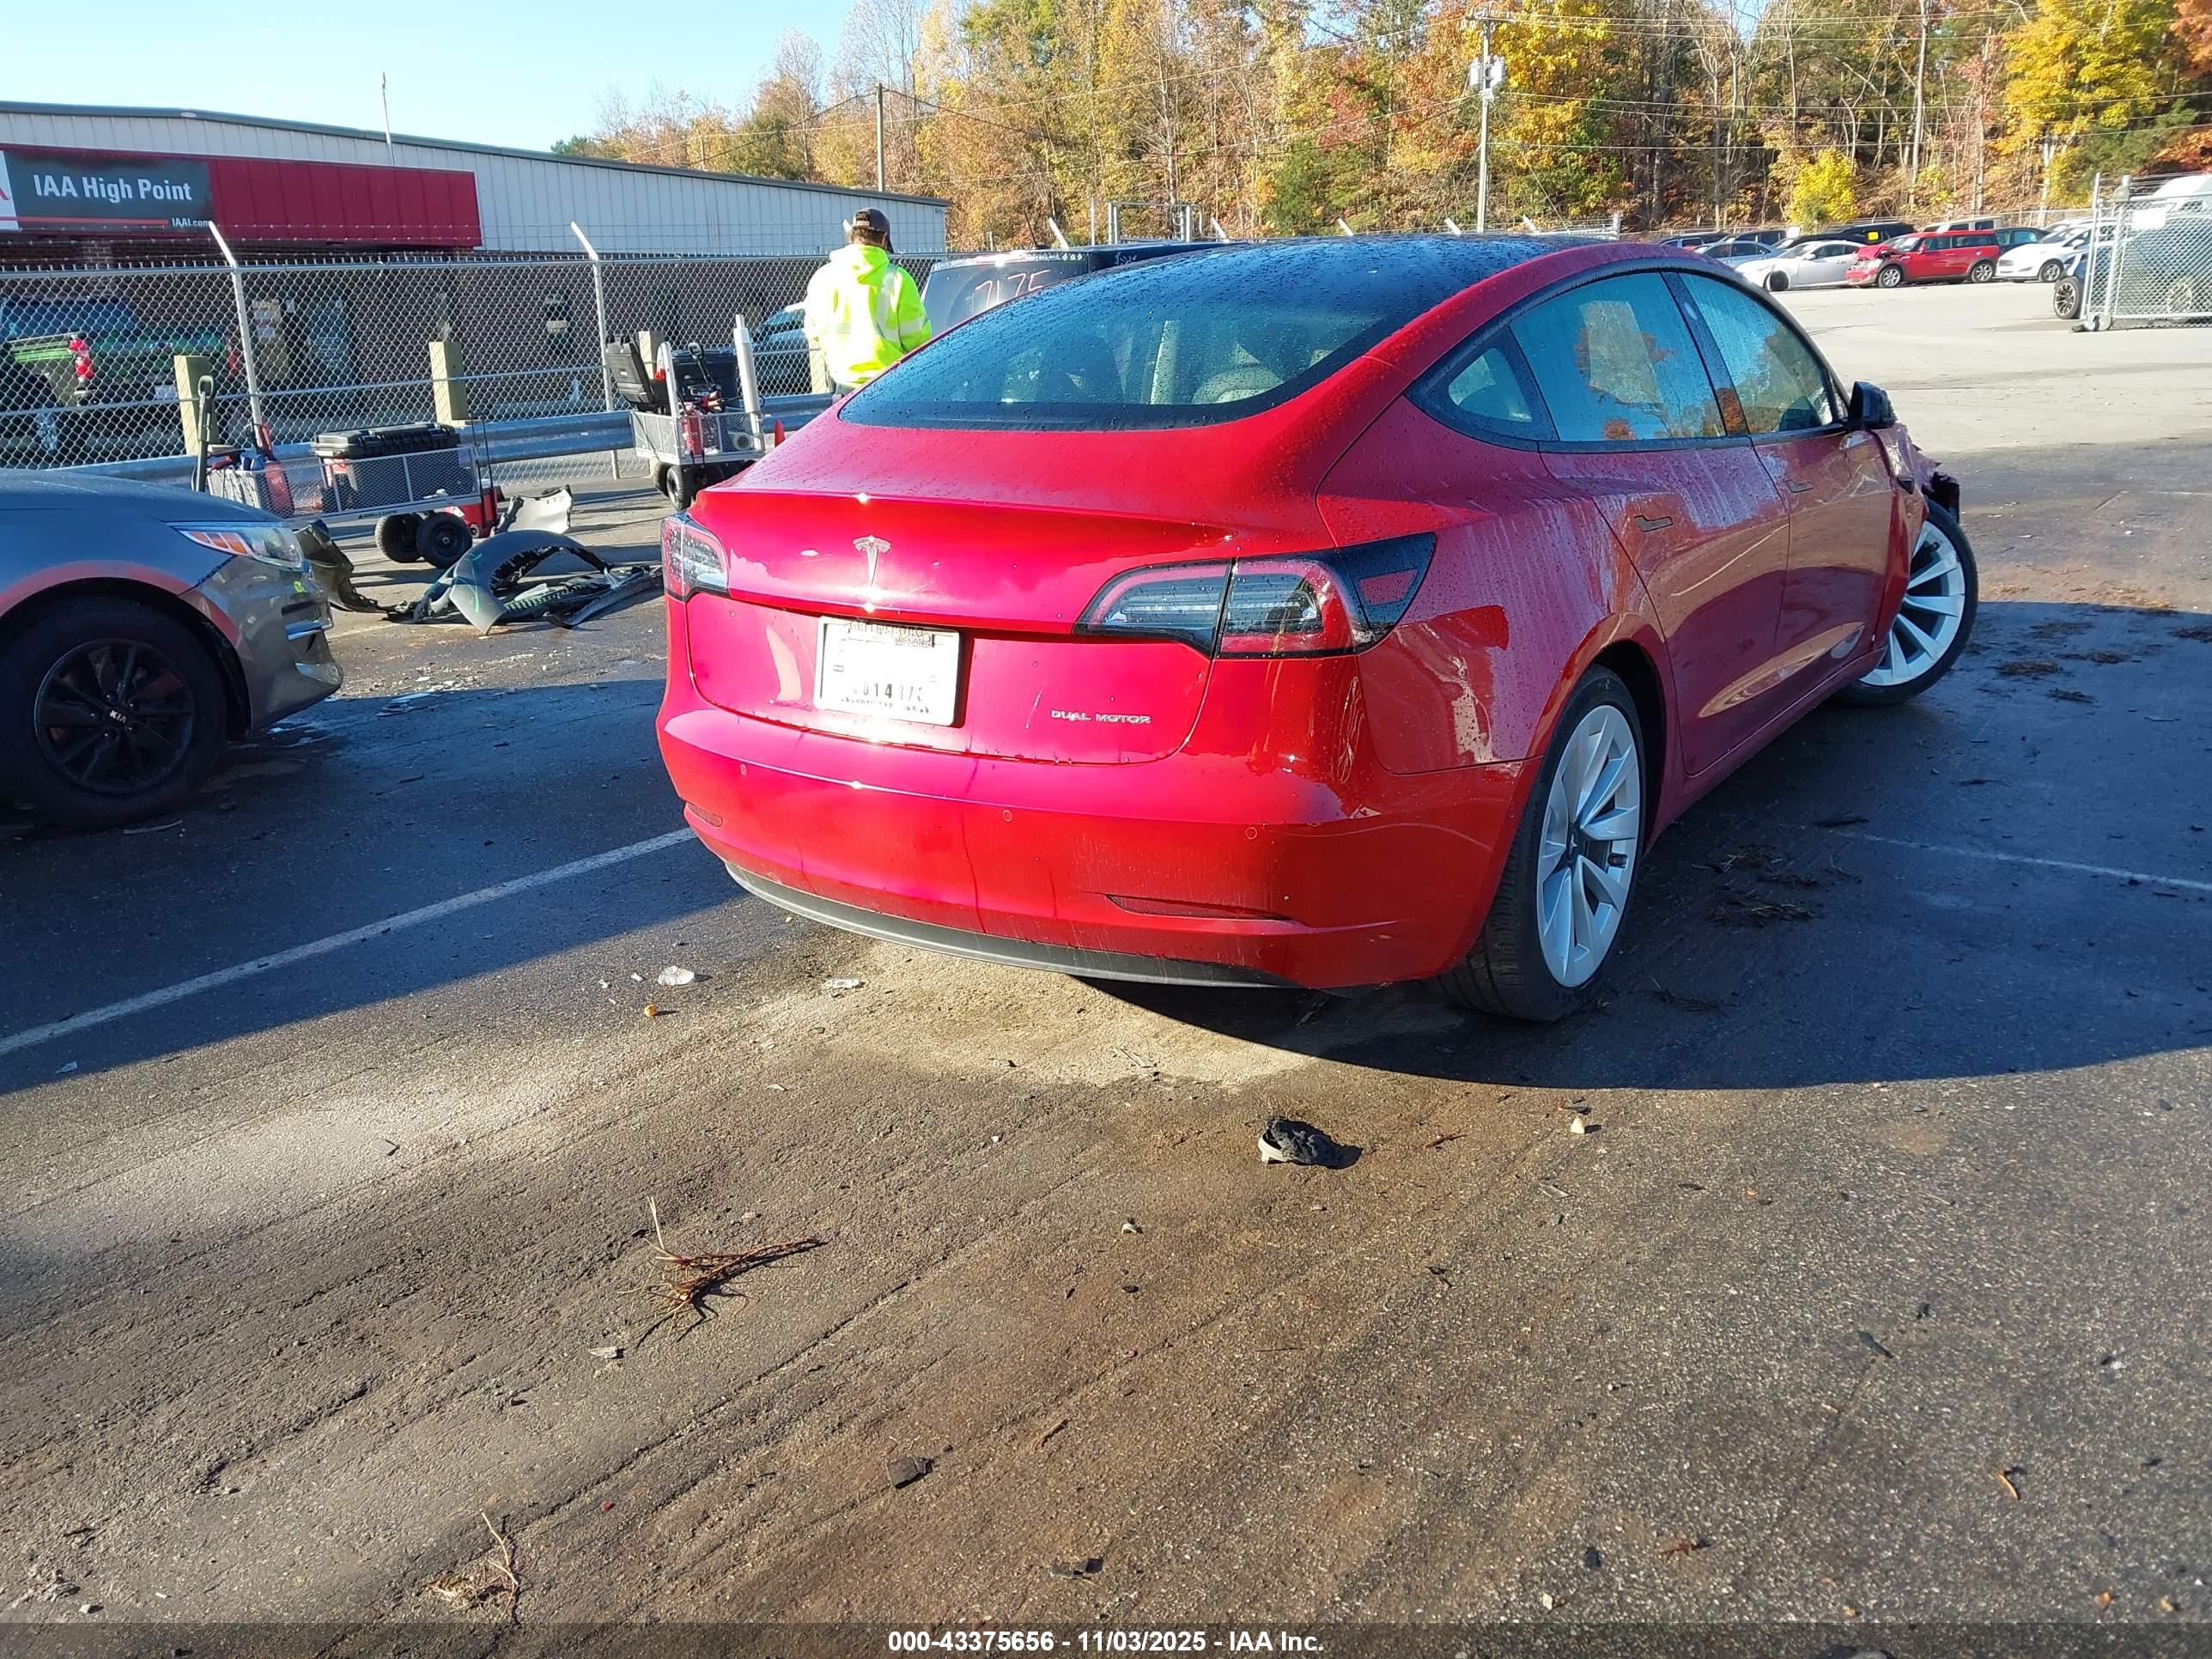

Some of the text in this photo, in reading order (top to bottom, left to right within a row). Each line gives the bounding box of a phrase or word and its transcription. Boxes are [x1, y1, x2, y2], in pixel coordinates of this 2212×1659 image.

[33, 174, 78, 198] IAA
[82, 177, 133, 204] High
[137, 179, 193, 201] Point
[109, 709, 126, 724] KIA
[1050, 709, 1152, 725] DUAL MOTOR
